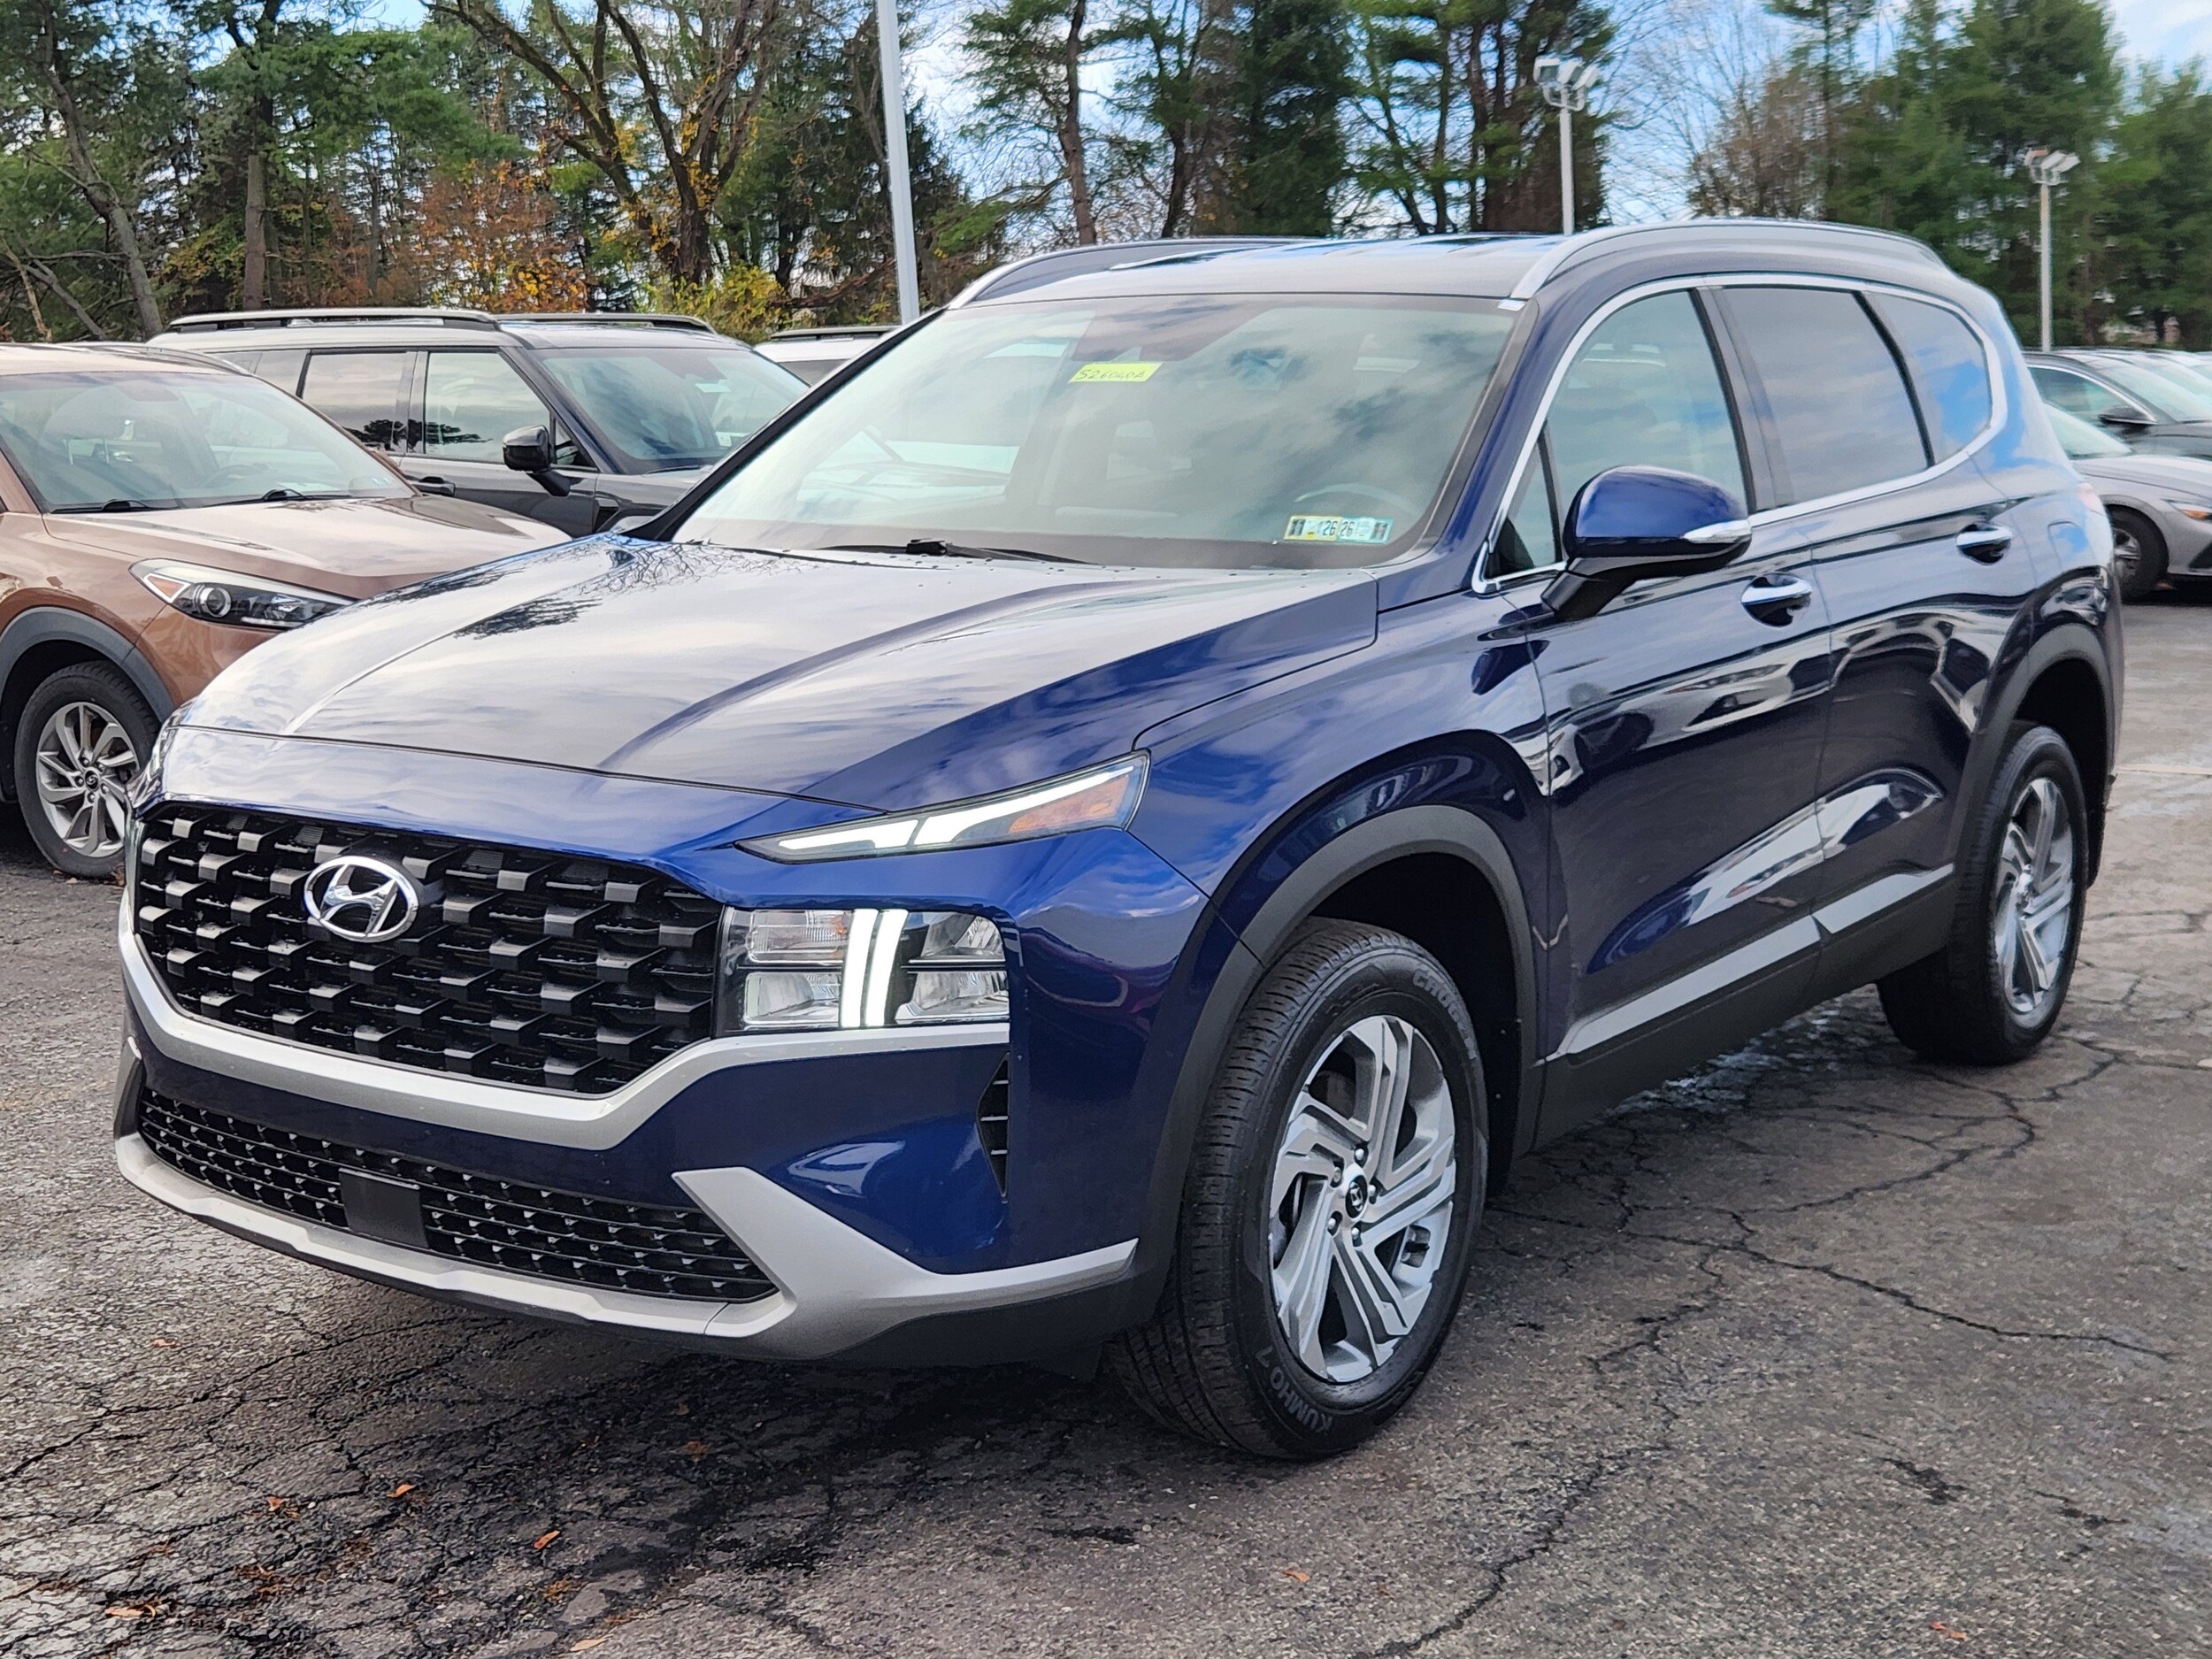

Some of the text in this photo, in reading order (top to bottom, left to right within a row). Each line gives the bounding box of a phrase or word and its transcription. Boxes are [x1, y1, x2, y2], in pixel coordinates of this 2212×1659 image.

[1323, 519, 1338, 535] 26
[1340, 521, 1355, 537] 26
[1270, 1366, 1333, 1433] KUMHO
